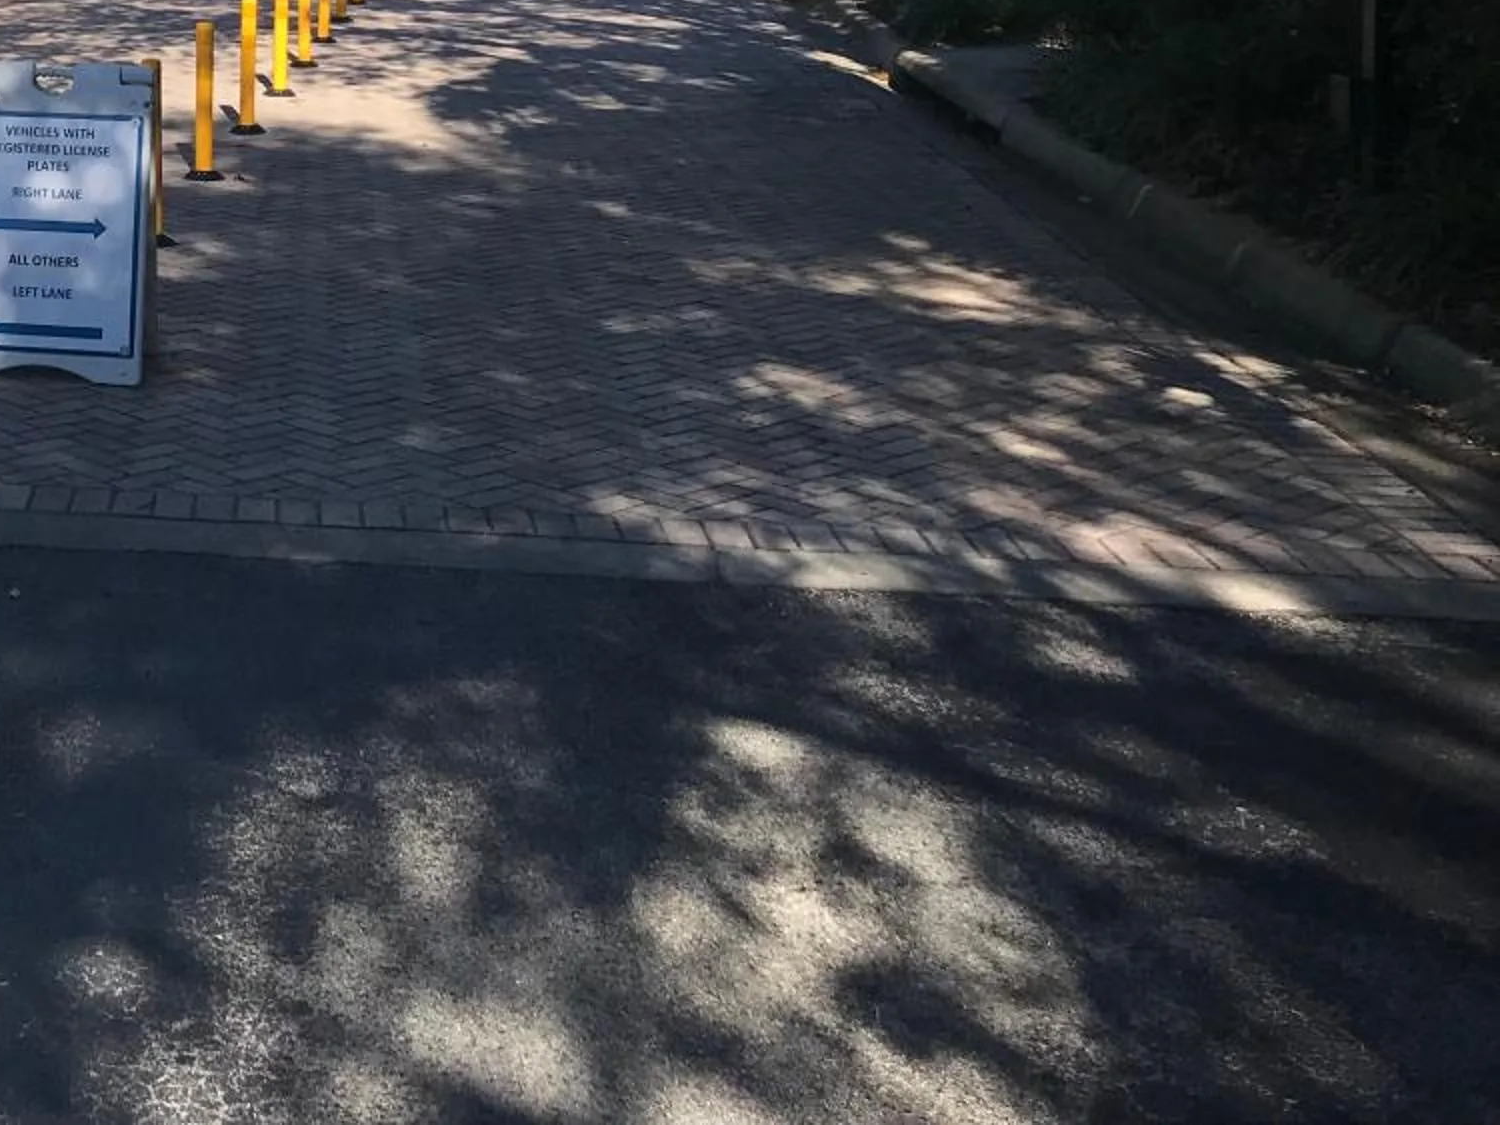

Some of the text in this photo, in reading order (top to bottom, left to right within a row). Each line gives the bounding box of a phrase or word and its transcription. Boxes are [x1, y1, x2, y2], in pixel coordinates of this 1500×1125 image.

[5, 126, 95, 140] VEHICLES WITH
[63, 145, 110, 158] LICENSE
[27, 160, 70, 172] PLATES
[11, 186, 83, 200] RIGHT LANE
[7, 253, 79, 268] ALL OTHERS
[12, 286, 73, 300] LEFT LANE
